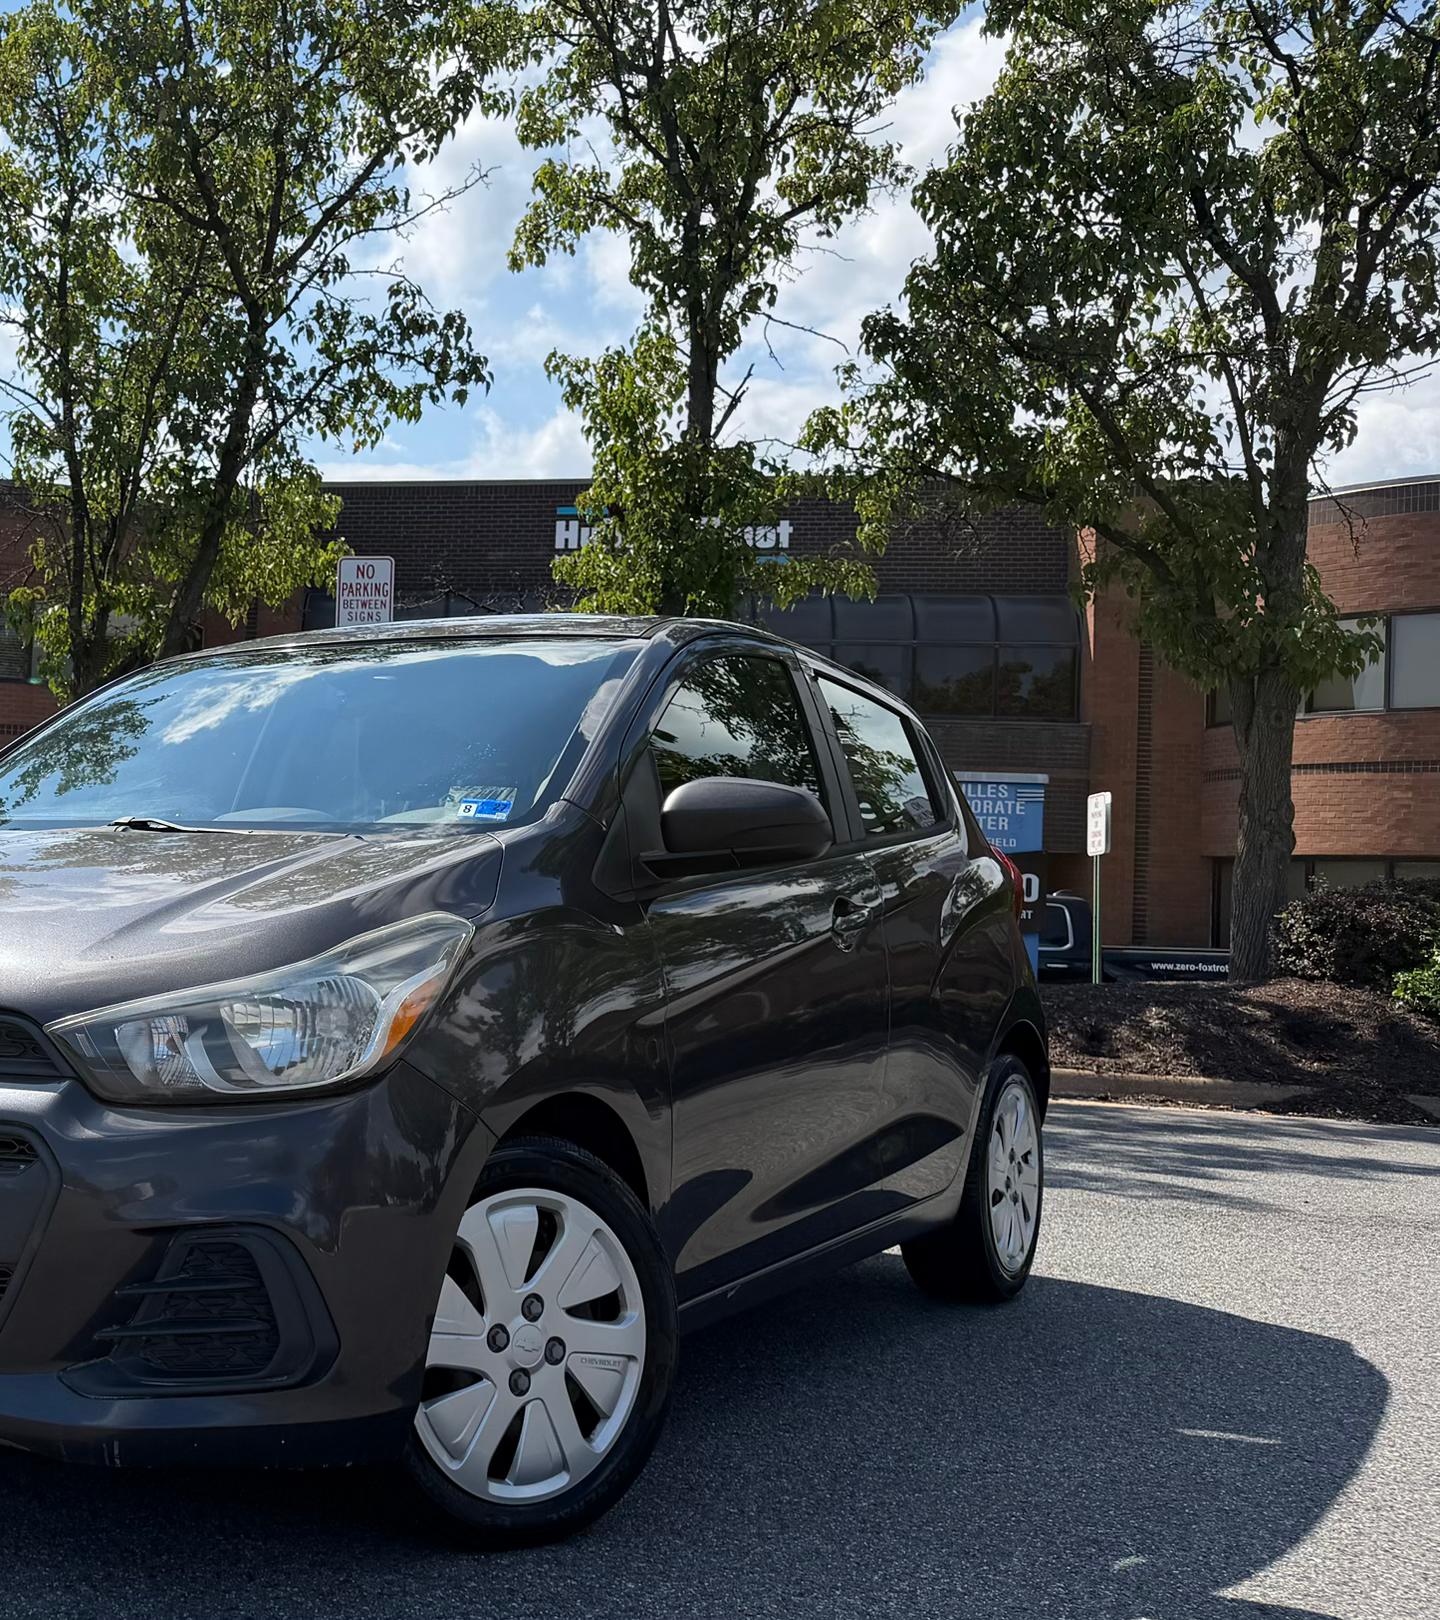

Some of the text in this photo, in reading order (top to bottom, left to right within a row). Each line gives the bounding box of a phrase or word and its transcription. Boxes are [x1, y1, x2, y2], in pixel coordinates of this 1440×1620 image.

[356, 564, 375, 579] NO
[341, 582, 389, 597] PARKING
[343, 600, 387, 609] BETWEEN
[347, 611, 381, 622] SIGNS
[463, 805, 472, 813] 8
[967, 800, 1025, 814] ORATE
